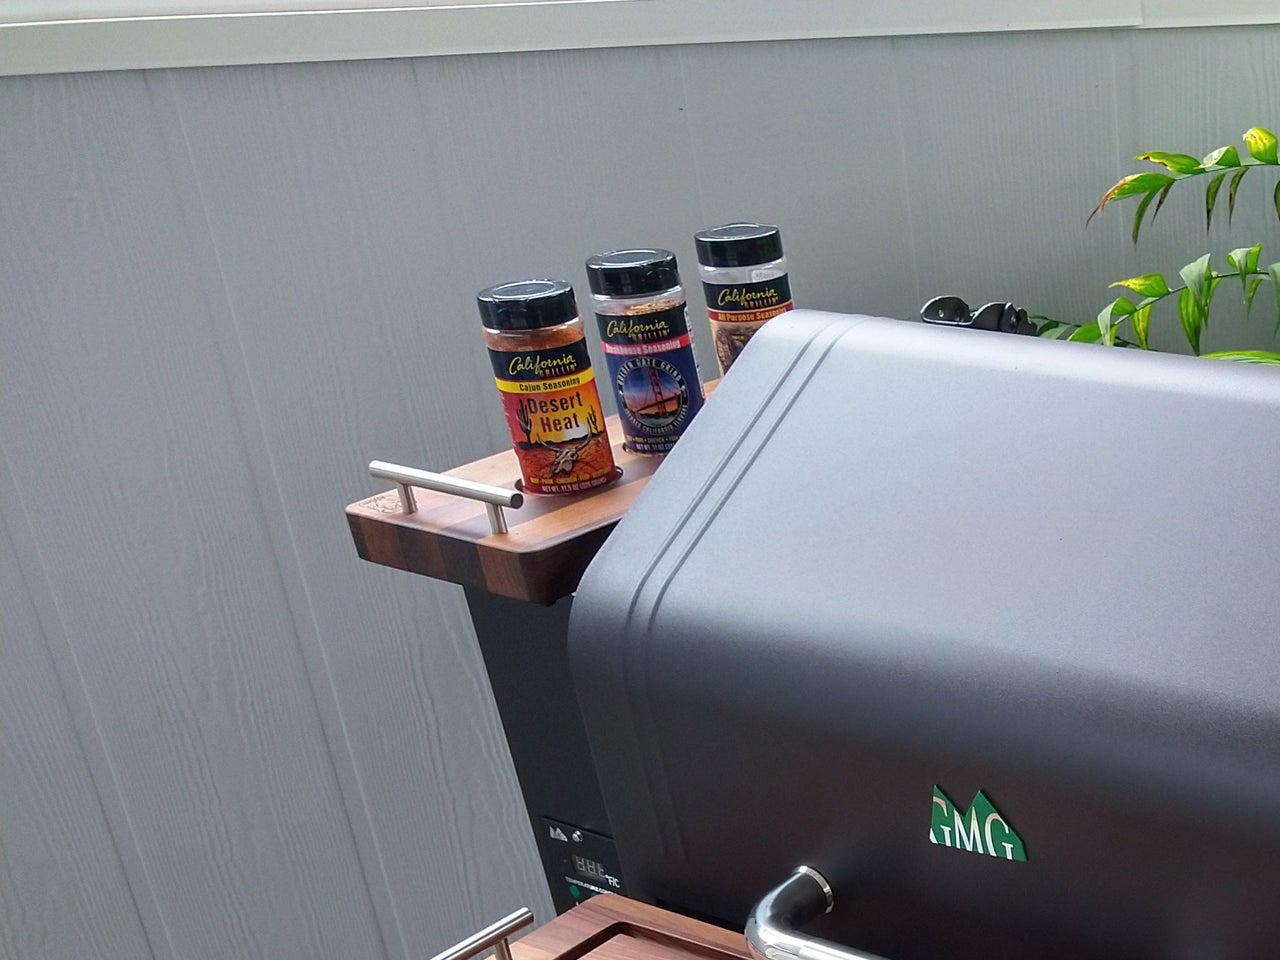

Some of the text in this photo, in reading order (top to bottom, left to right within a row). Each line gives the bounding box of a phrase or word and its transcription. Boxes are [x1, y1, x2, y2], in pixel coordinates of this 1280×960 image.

[718, 287, 778, 306] California
[607, 319, 669, 338] California
[508, 353, 576, 375] California
[519, 376, 581, 392] Cajun Seasoning
[528, 391, 583, 414] Desert
[540, 413, 580, 433] Heat
[929, 796, 1014, 860] GMG
